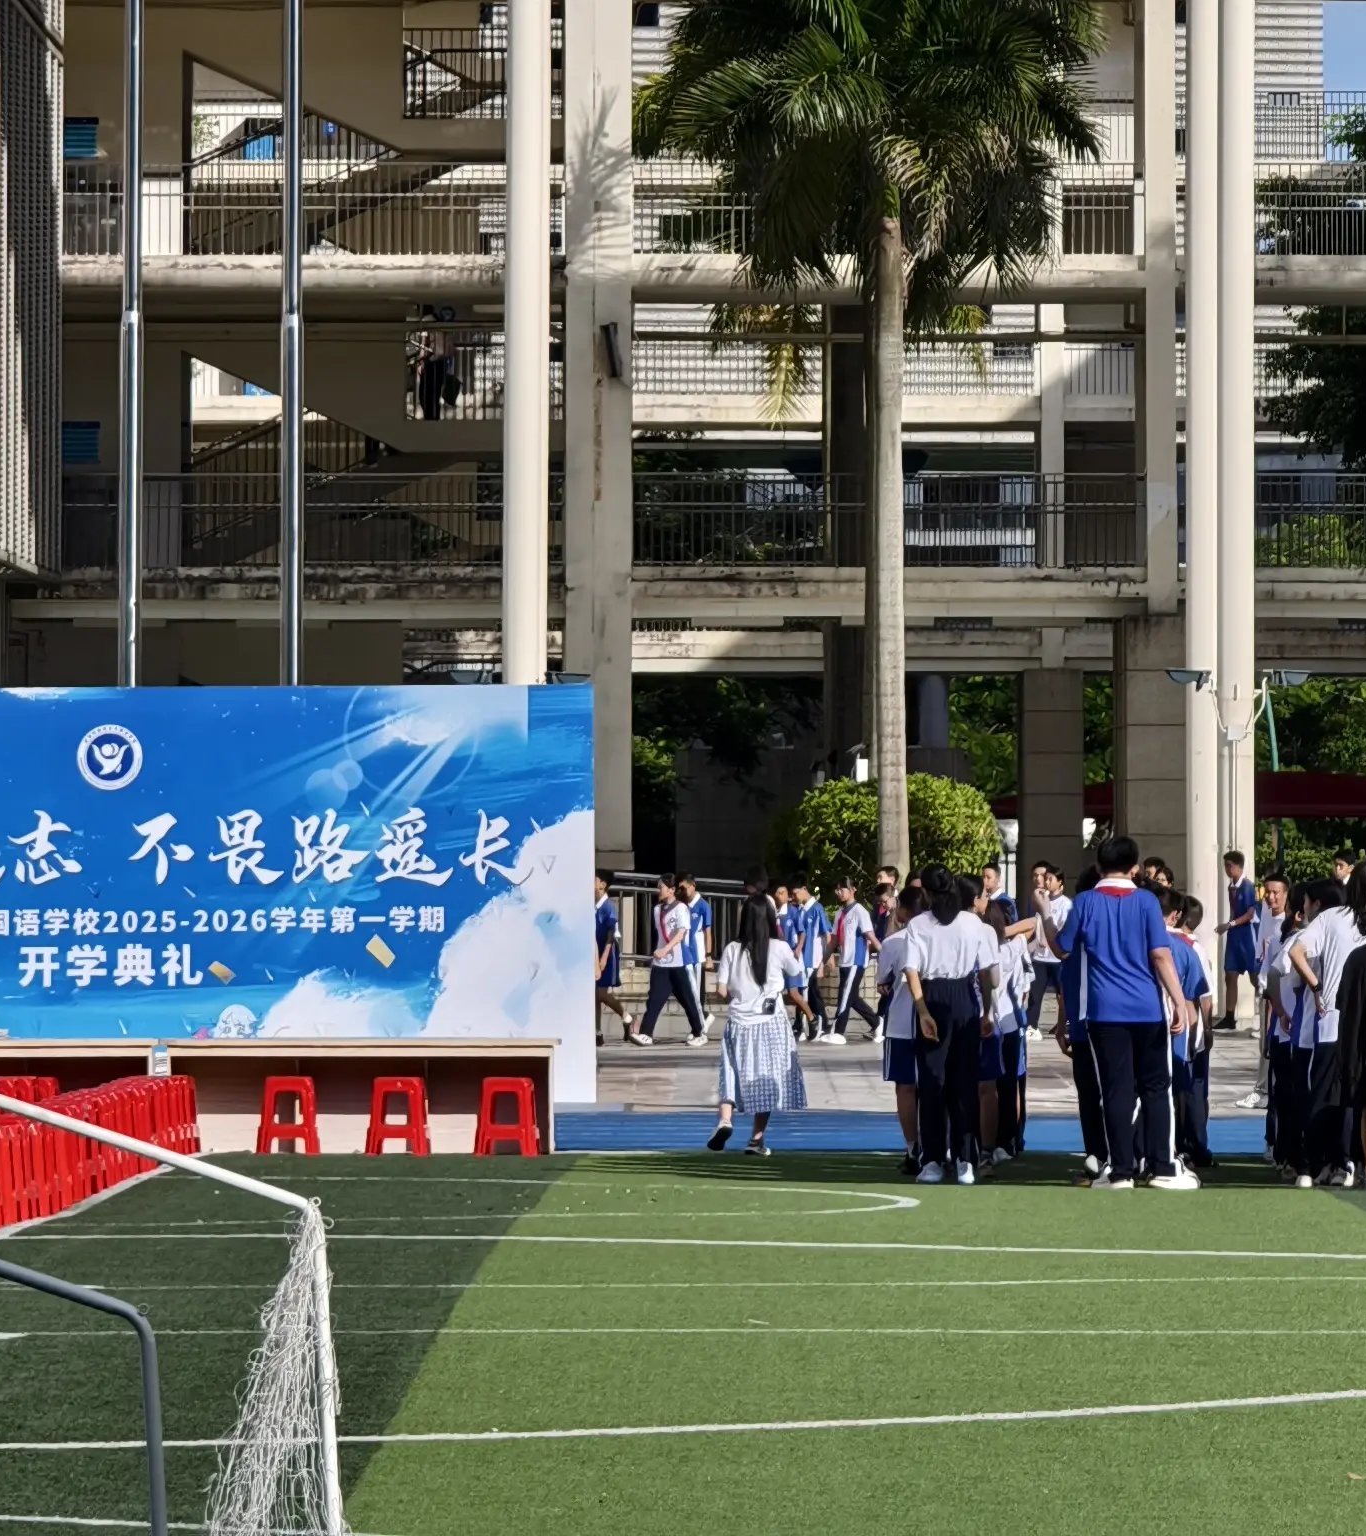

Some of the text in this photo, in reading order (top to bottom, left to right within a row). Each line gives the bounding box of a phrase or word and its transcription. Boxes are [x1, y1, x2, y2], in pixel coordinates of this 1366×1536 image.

[127, 807, 535, 887] 不畏路遥长
[17, 943, 204, 989] 开学典礼
